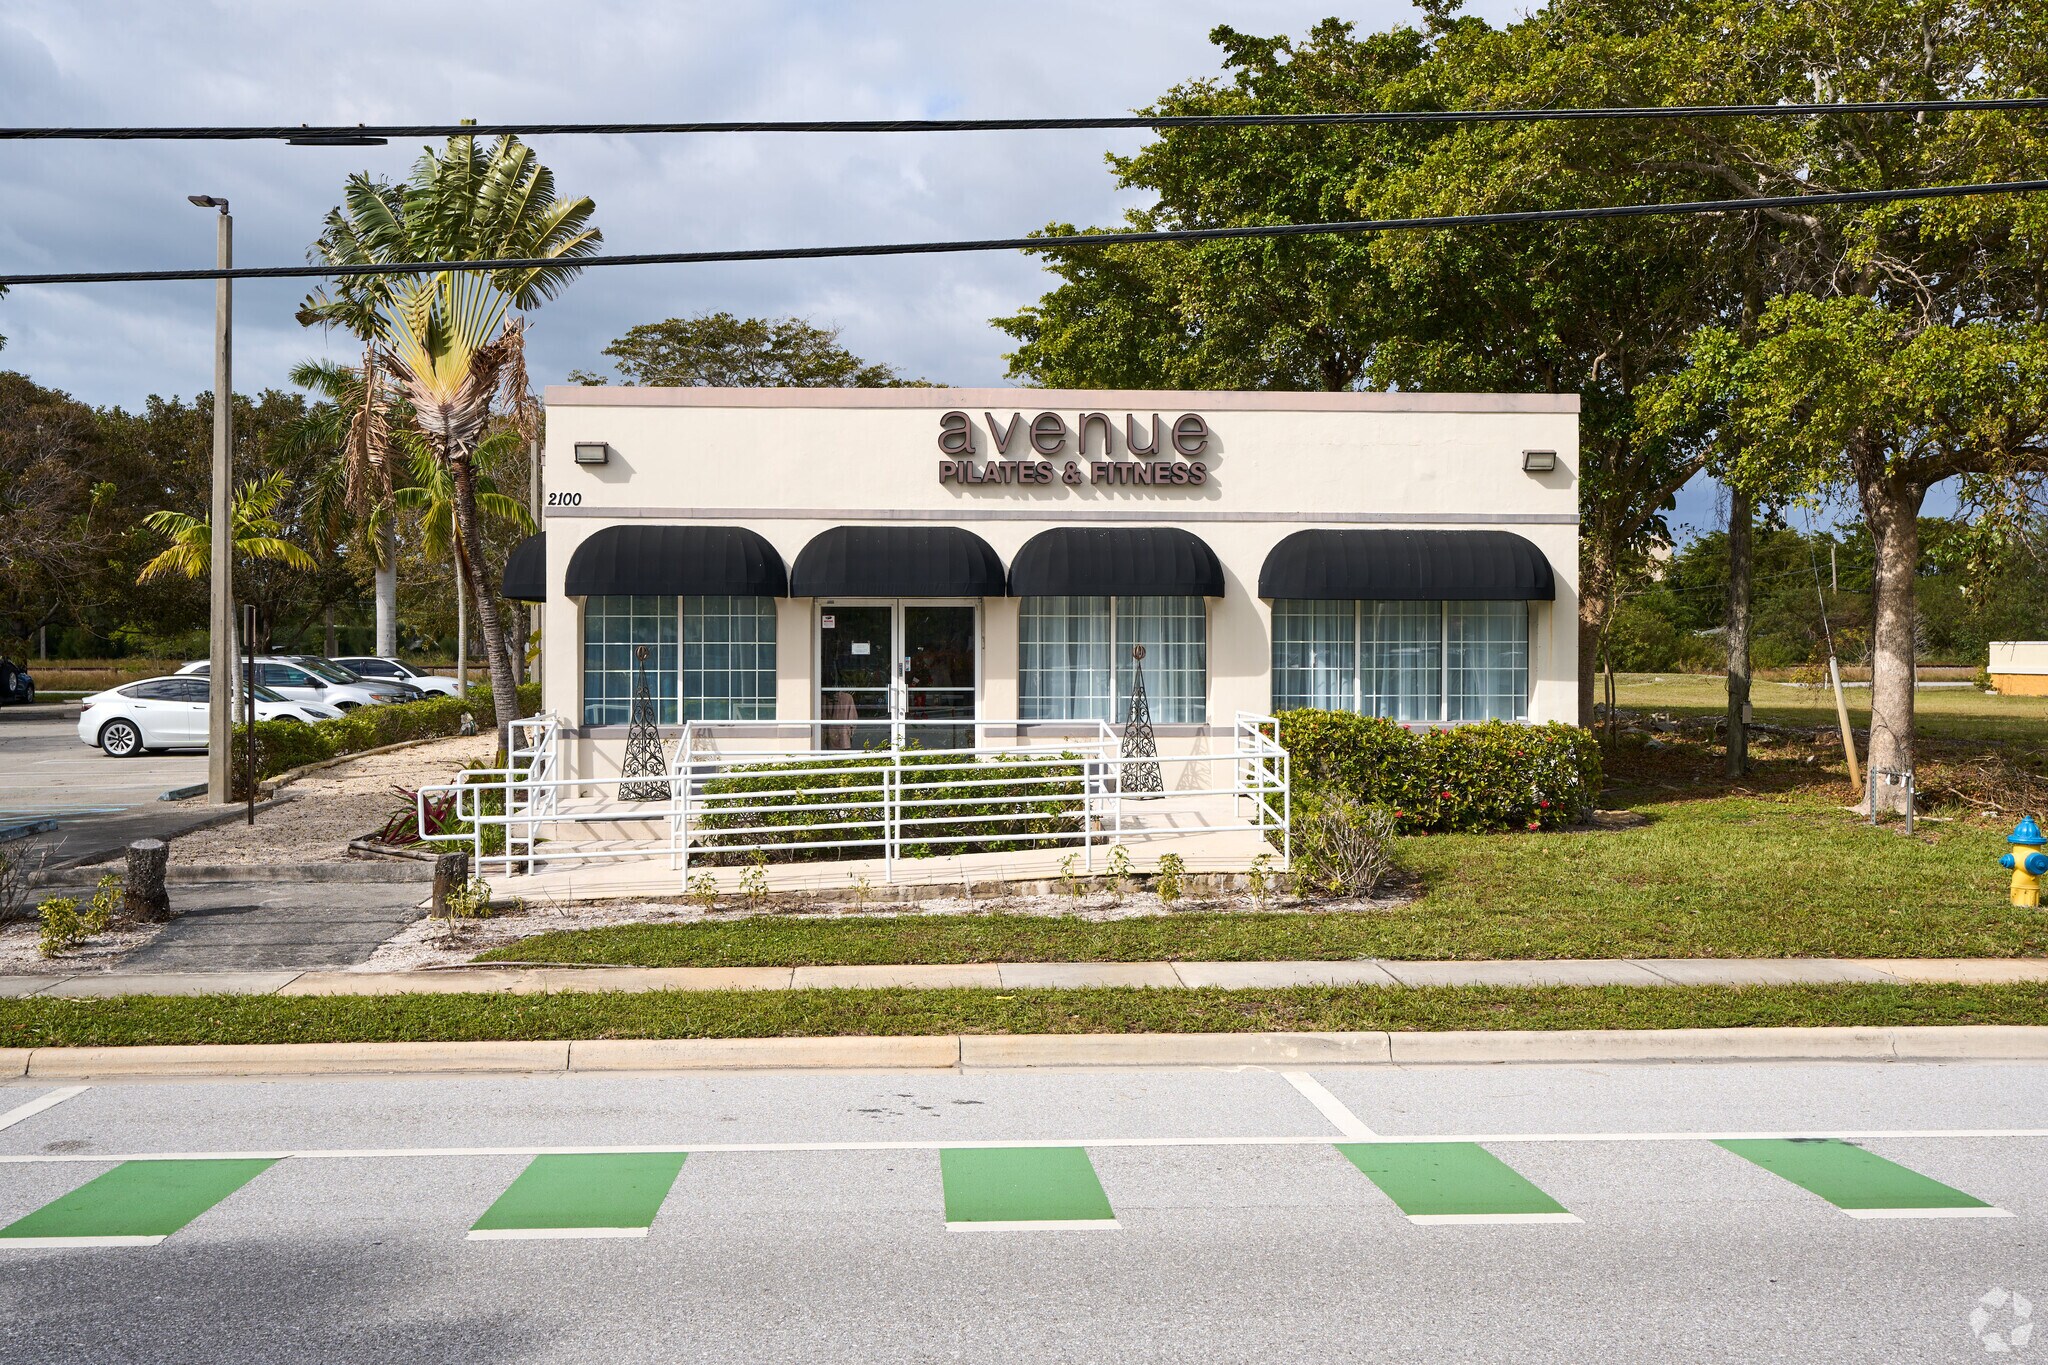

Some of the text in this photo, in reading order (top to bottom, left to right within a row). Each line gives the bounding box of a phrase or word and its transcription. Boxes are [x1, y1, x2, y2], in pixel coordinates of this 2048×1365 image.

[938, 411, 1209, 455] avenue
[939, 461, 1207, 485] PILATES & FITNESS
[548, 492, 582, 506] 2100
